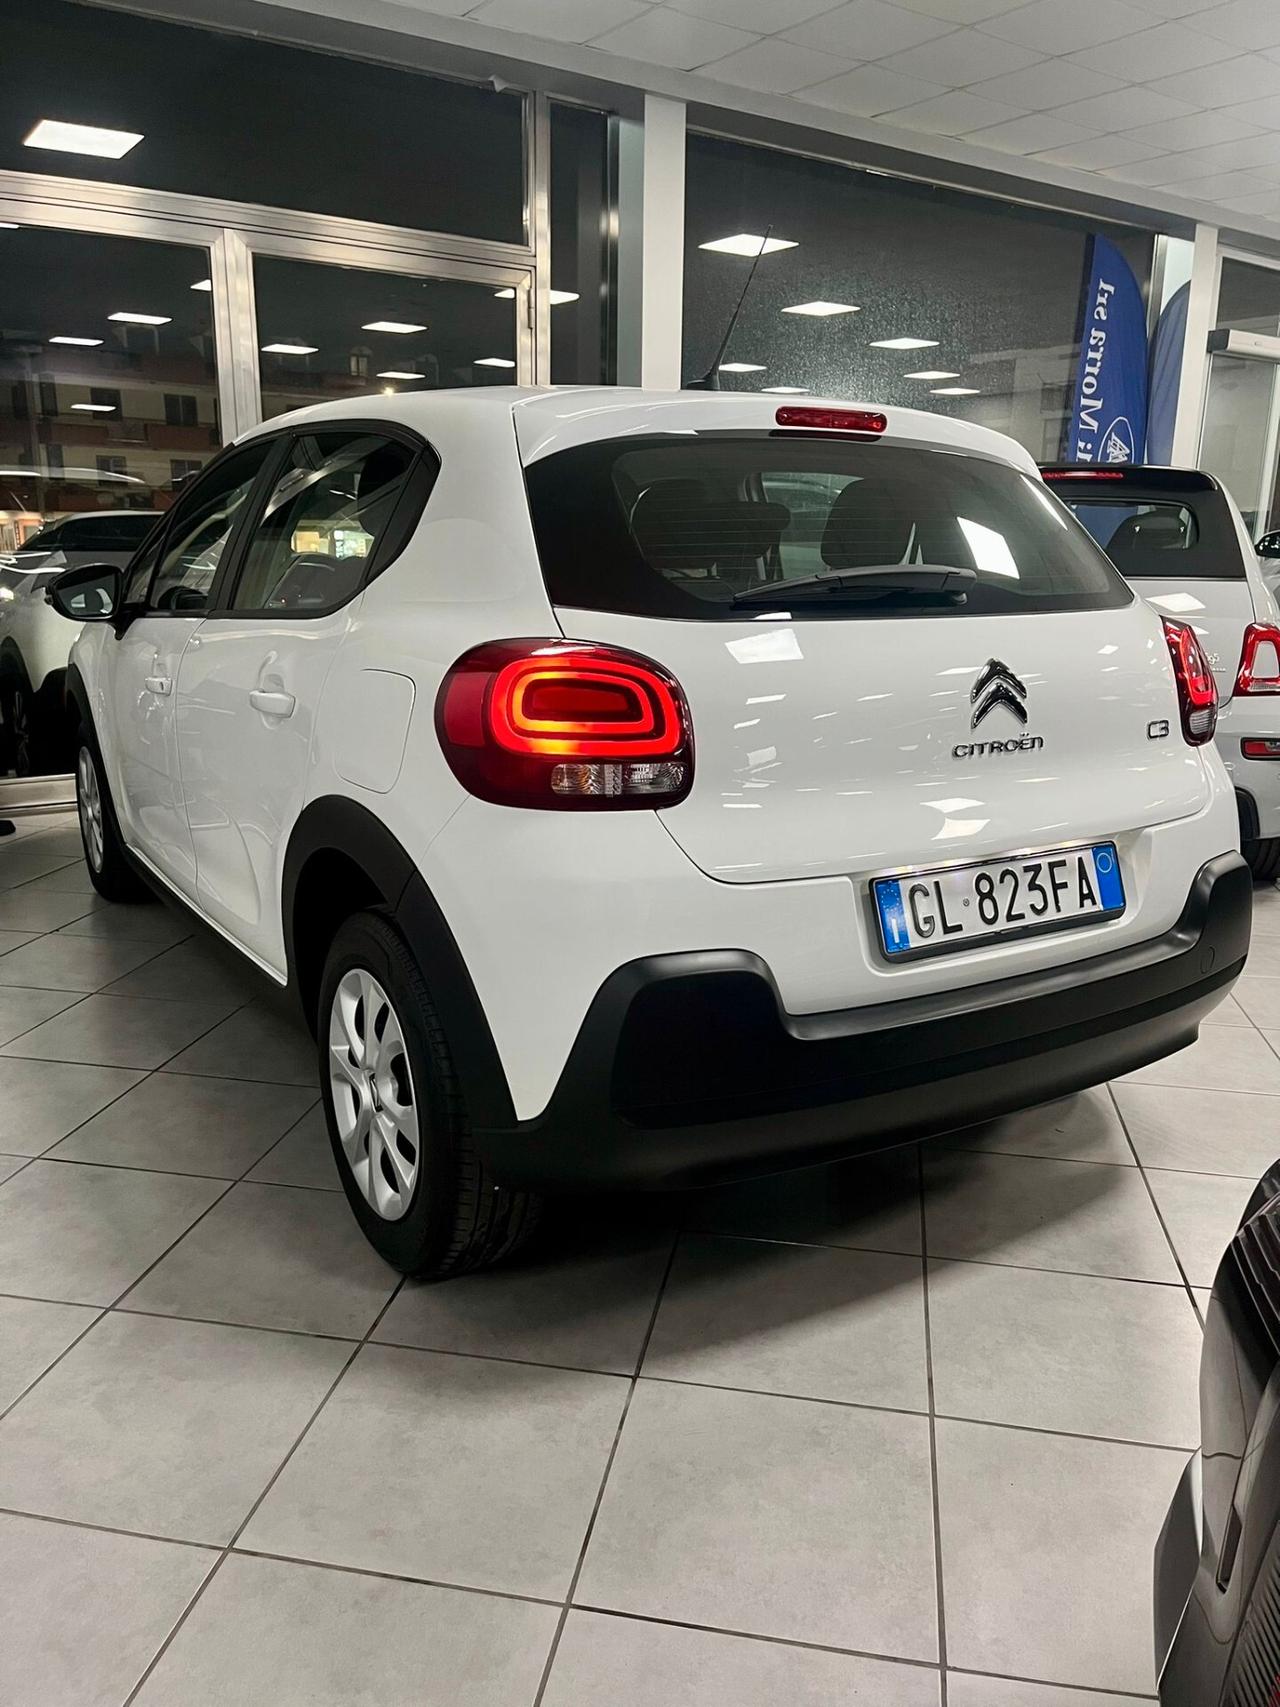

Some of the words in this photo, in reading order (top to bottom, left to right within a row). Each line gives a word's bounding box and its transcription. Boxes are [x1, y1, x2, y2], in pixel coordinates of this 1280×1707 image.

[1147, 719, 1169, 739] C3
[952, 733, 1044, 758] CITROËN
[908, 880, 963, 938] GL
[974, 856, 1097, 925] 823FA
